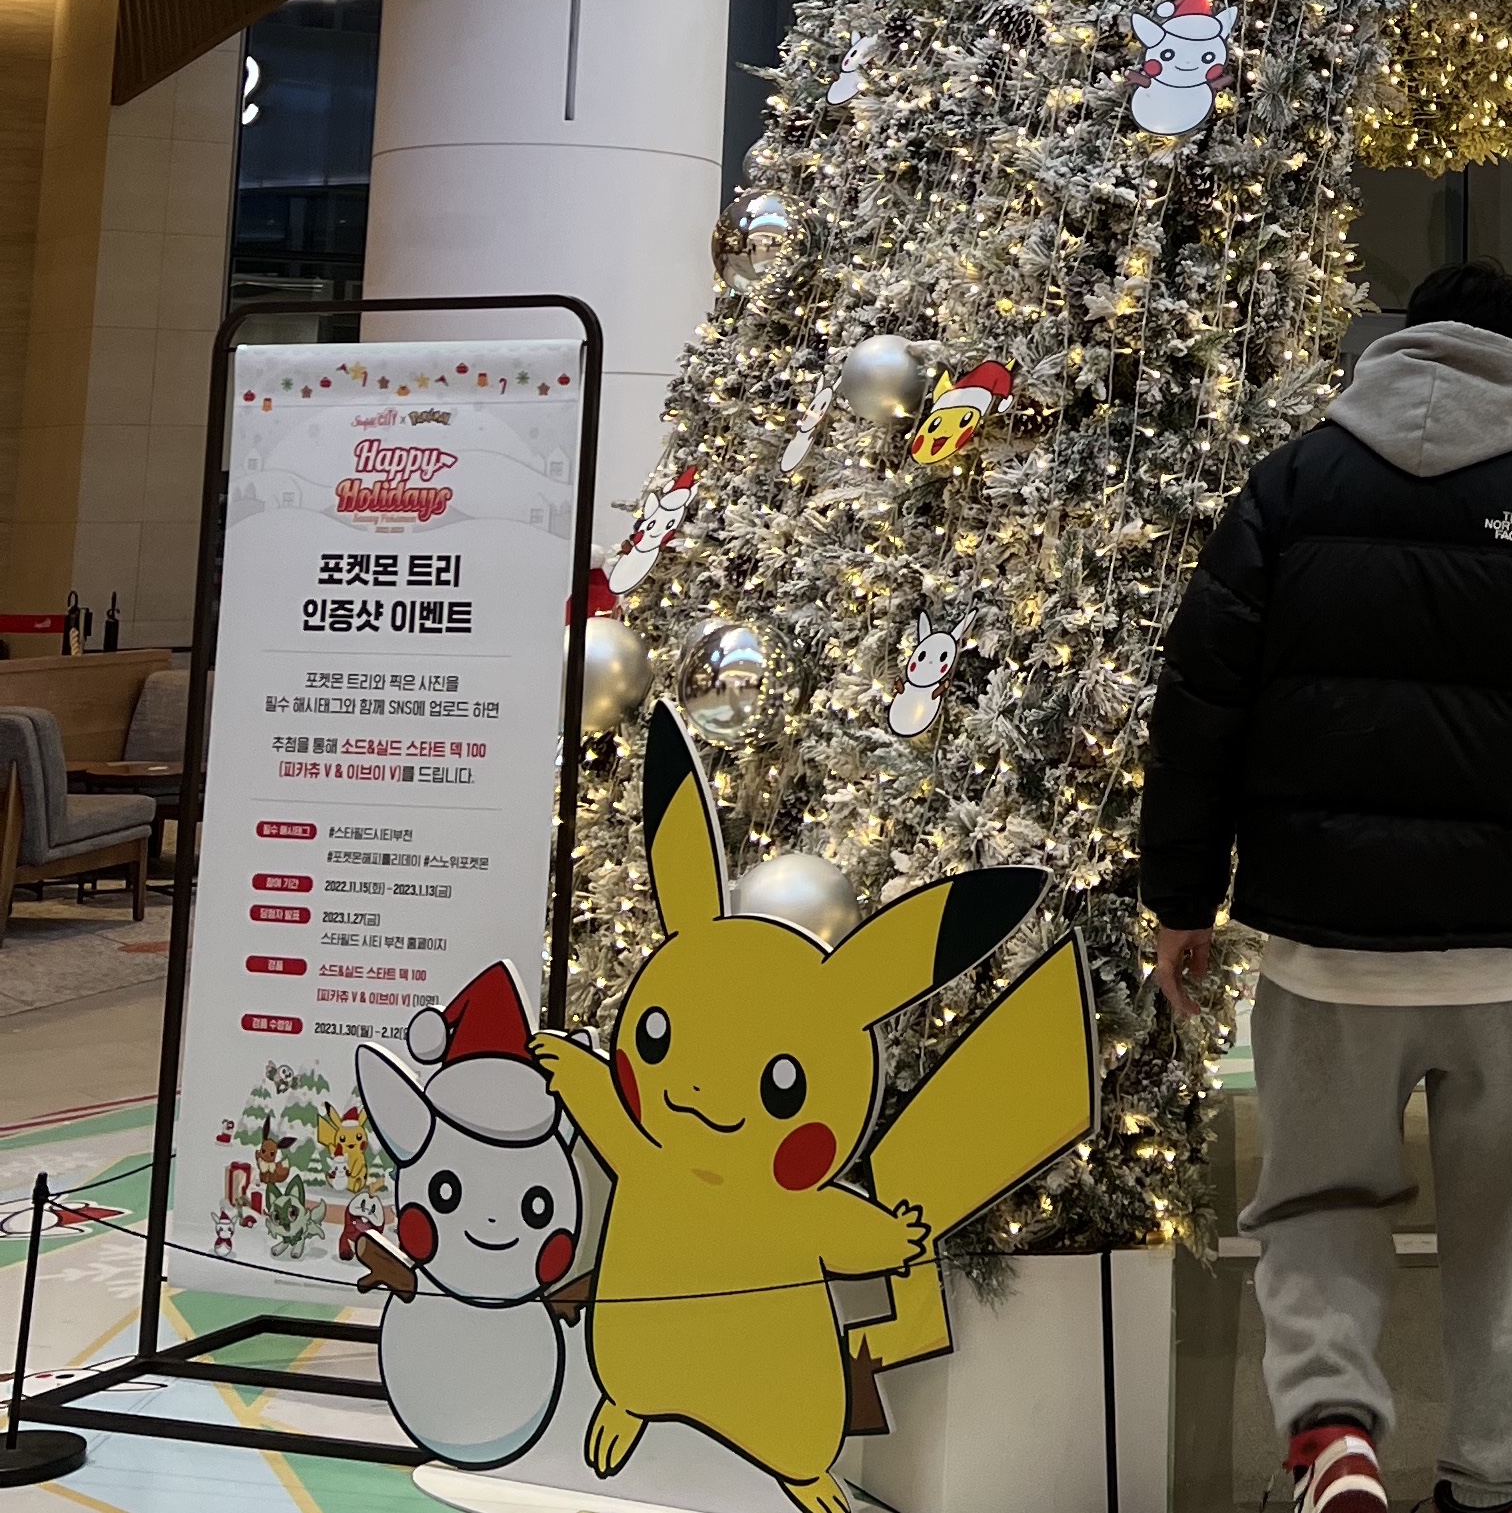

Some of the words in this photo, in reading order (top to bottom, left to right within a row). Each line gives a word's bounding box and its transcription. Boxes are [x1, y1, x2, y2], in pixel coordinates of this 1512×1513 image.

[354, 438, 458, 482] Happy
[335, 478, 453, 522] Holidays
[318, 553, 399, 586] 포켓몬
[406, 554, 462, 588] 트리
[302, 599, 384, 632] 인증샷
[390, 600, 472, 634] 이벤트
[305, 672, 344, 689] 포켓몬
[346, 674, 386, 691] 트리와
[389, 674, 415, 691] 찍은
[419, 675, 459, 692] 사진을
[265, 695, 290, 713] 필수
[293, 696, 356, 715] 해시태그와
[359, 698, 385, 715] 함께
[389, 699, 426, 716] SNS에
[429, 700, 469, 718] 업로드
[473, 701, 500, 719] 하면
[271, 736, 309, 754] 추첨을
[312, 737, 339, 754] 통해
[340, 738, 402, 757] 소드&실드
[405, 740, 446, 758] 스타트
[450, 741, 462, 759] 덱
[466, 742, 487, 758] 100
[324, 763, 332, 778] V
[334, 763, 343, 779] &
[346, 764, 386, 781] 이브이
[418, 766, 475, 785] 드립니다.
[318, 963, 364, 979] 소드&실드
[366, 966, 397, 981] 스타트
[411, 969, 427, 982] 100
[351, 991, 358, 1003] V
[359, 991, 366, 1003] &
[368, 992, 399, 1006] 이브이
